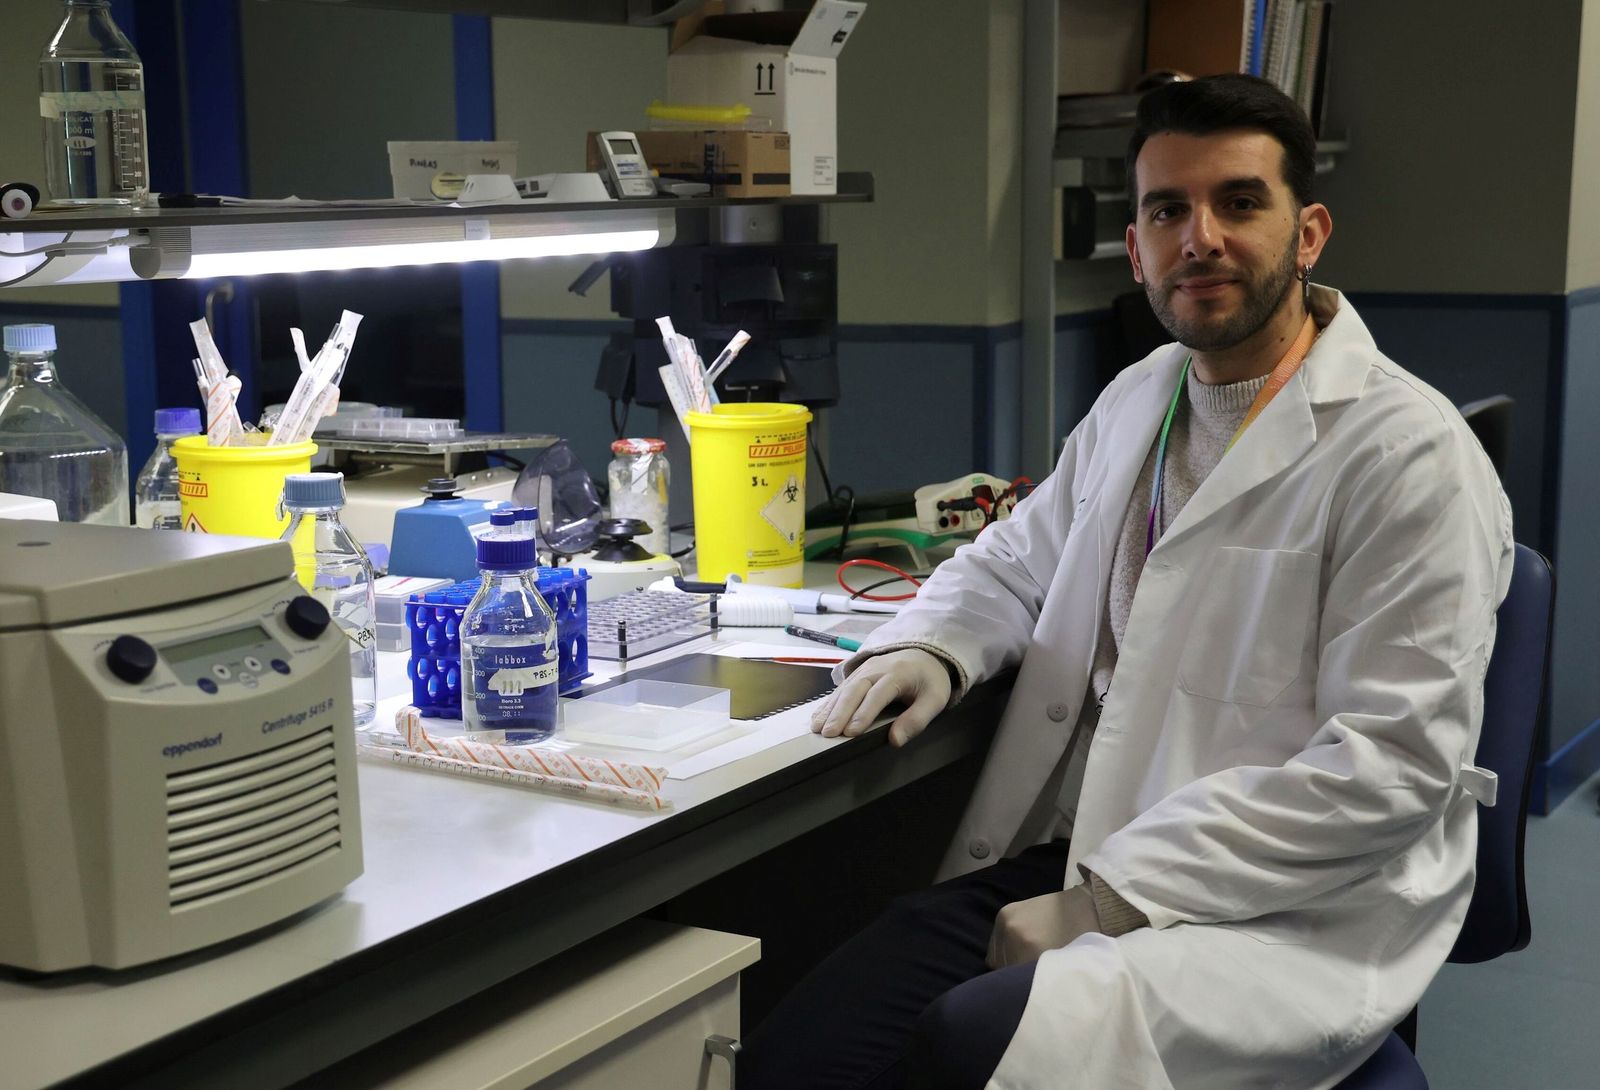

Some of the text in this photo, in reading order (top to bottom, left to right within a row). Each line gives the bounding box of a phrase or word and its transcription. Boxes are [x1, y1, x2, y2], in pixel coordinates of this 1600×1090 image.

[752, 476, 758, 487] 3
[474, 647, 485, 655] 400
[495, 655, 526, 664] labbox
[474, 670, 486, 678] 300
[475, 692, 486, 700] 200
[262, 697, 334, 734] Centrifuge 5415 R
[162, 732, 223, 758] eppendorf
